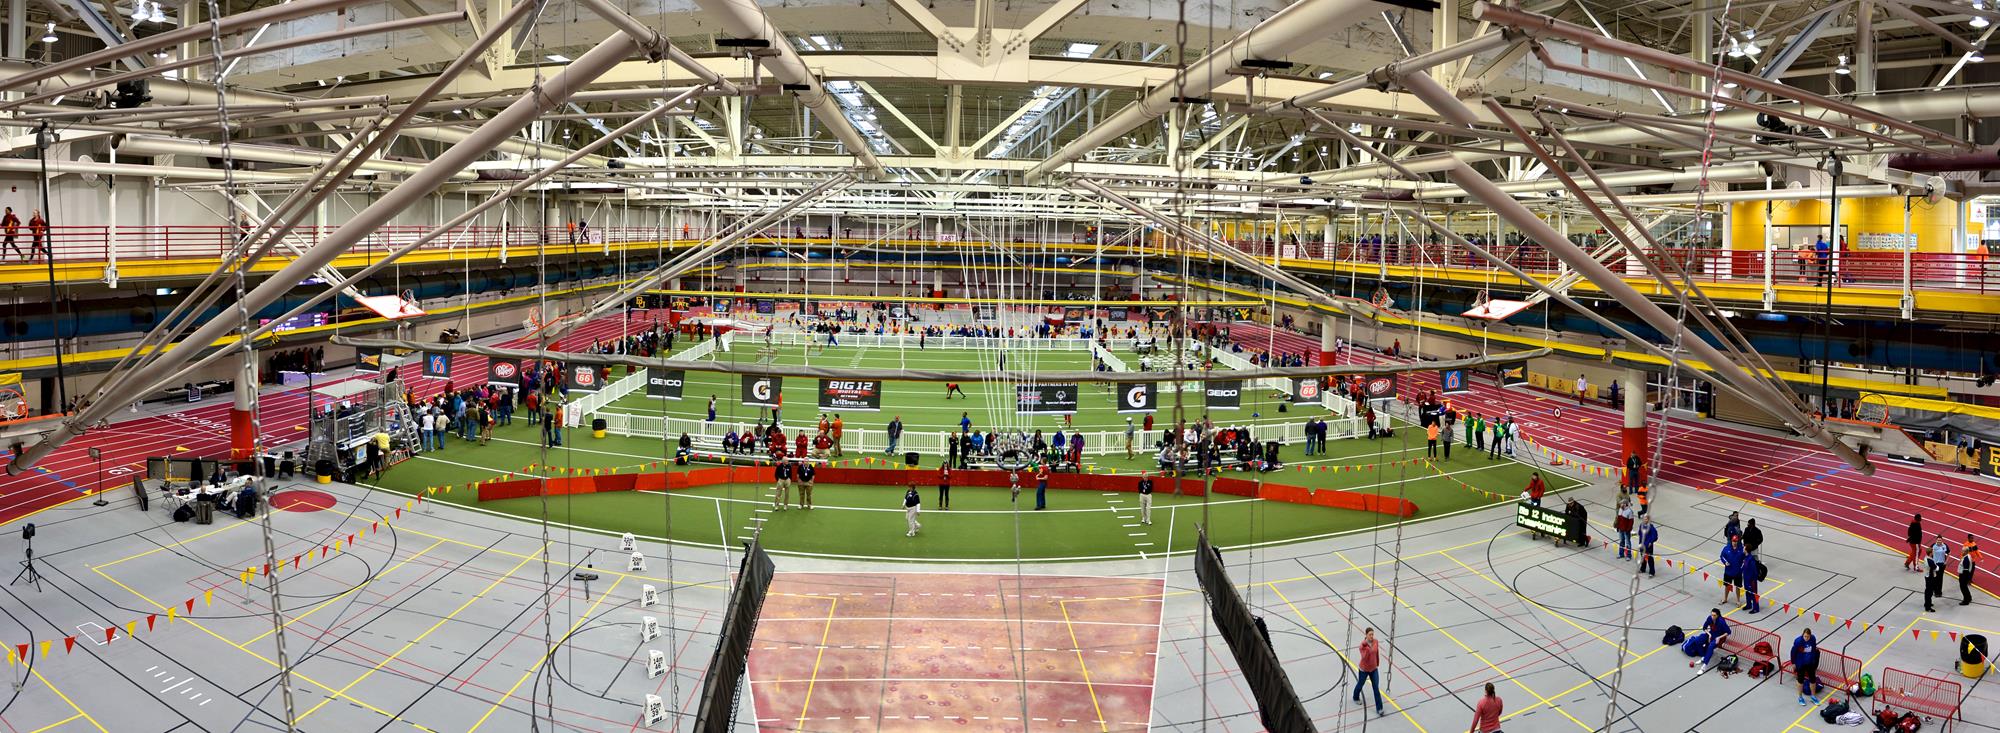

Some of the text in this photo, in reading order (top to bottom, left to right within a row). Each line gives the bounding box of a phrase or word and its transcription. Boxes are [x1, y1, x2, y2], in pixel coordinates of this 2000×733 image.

[432, 356, 444, 374] 6
[650, 378, 682, 386] GEICO
[829, 381, 873, 390] BIG 12
[1448, 370, 1458, 388] 6
[752, 379, 770, 400] G
[1127, 386, 1146, 408] G
[1518, 516, 1566, 536] Championships
[1532, 510, 1539, 519] 12
[1542, 512, 1565, 525] Indoor
[650, 702, 661, 710] 12m
